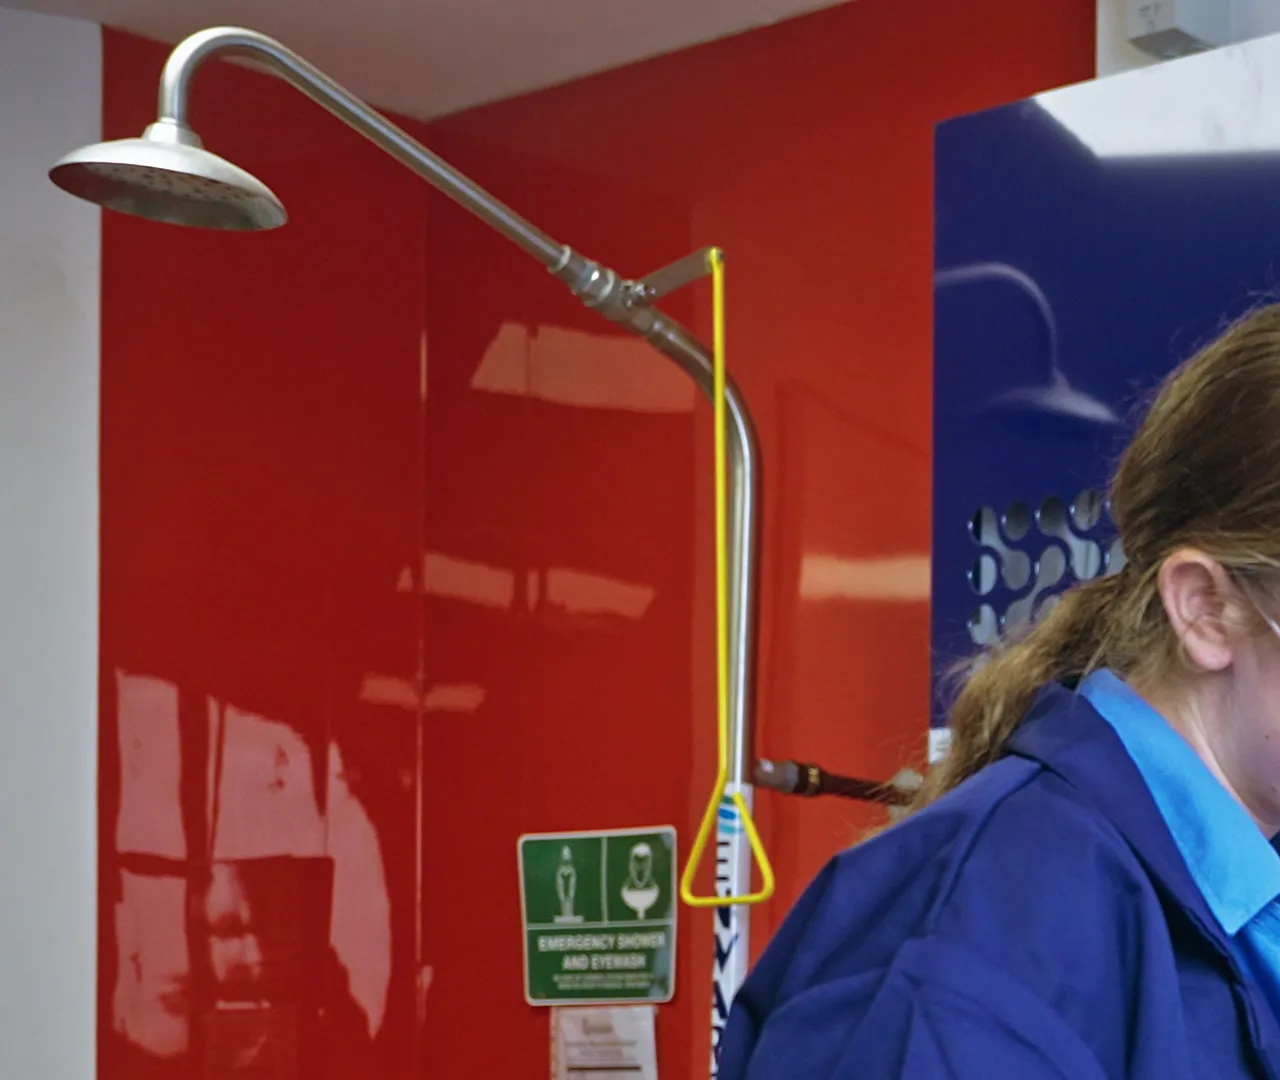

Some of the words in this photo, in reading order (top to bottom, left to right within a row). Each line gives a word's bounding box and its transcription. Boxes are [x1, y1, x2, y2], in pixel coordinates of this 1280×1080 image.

[538, 934, 616, 952] EMERGENCY
[617, 932, 665, 949] SHOWER
[562, 954, 589, 970] AND
[591, 953, 646, 970] EYEWASH
